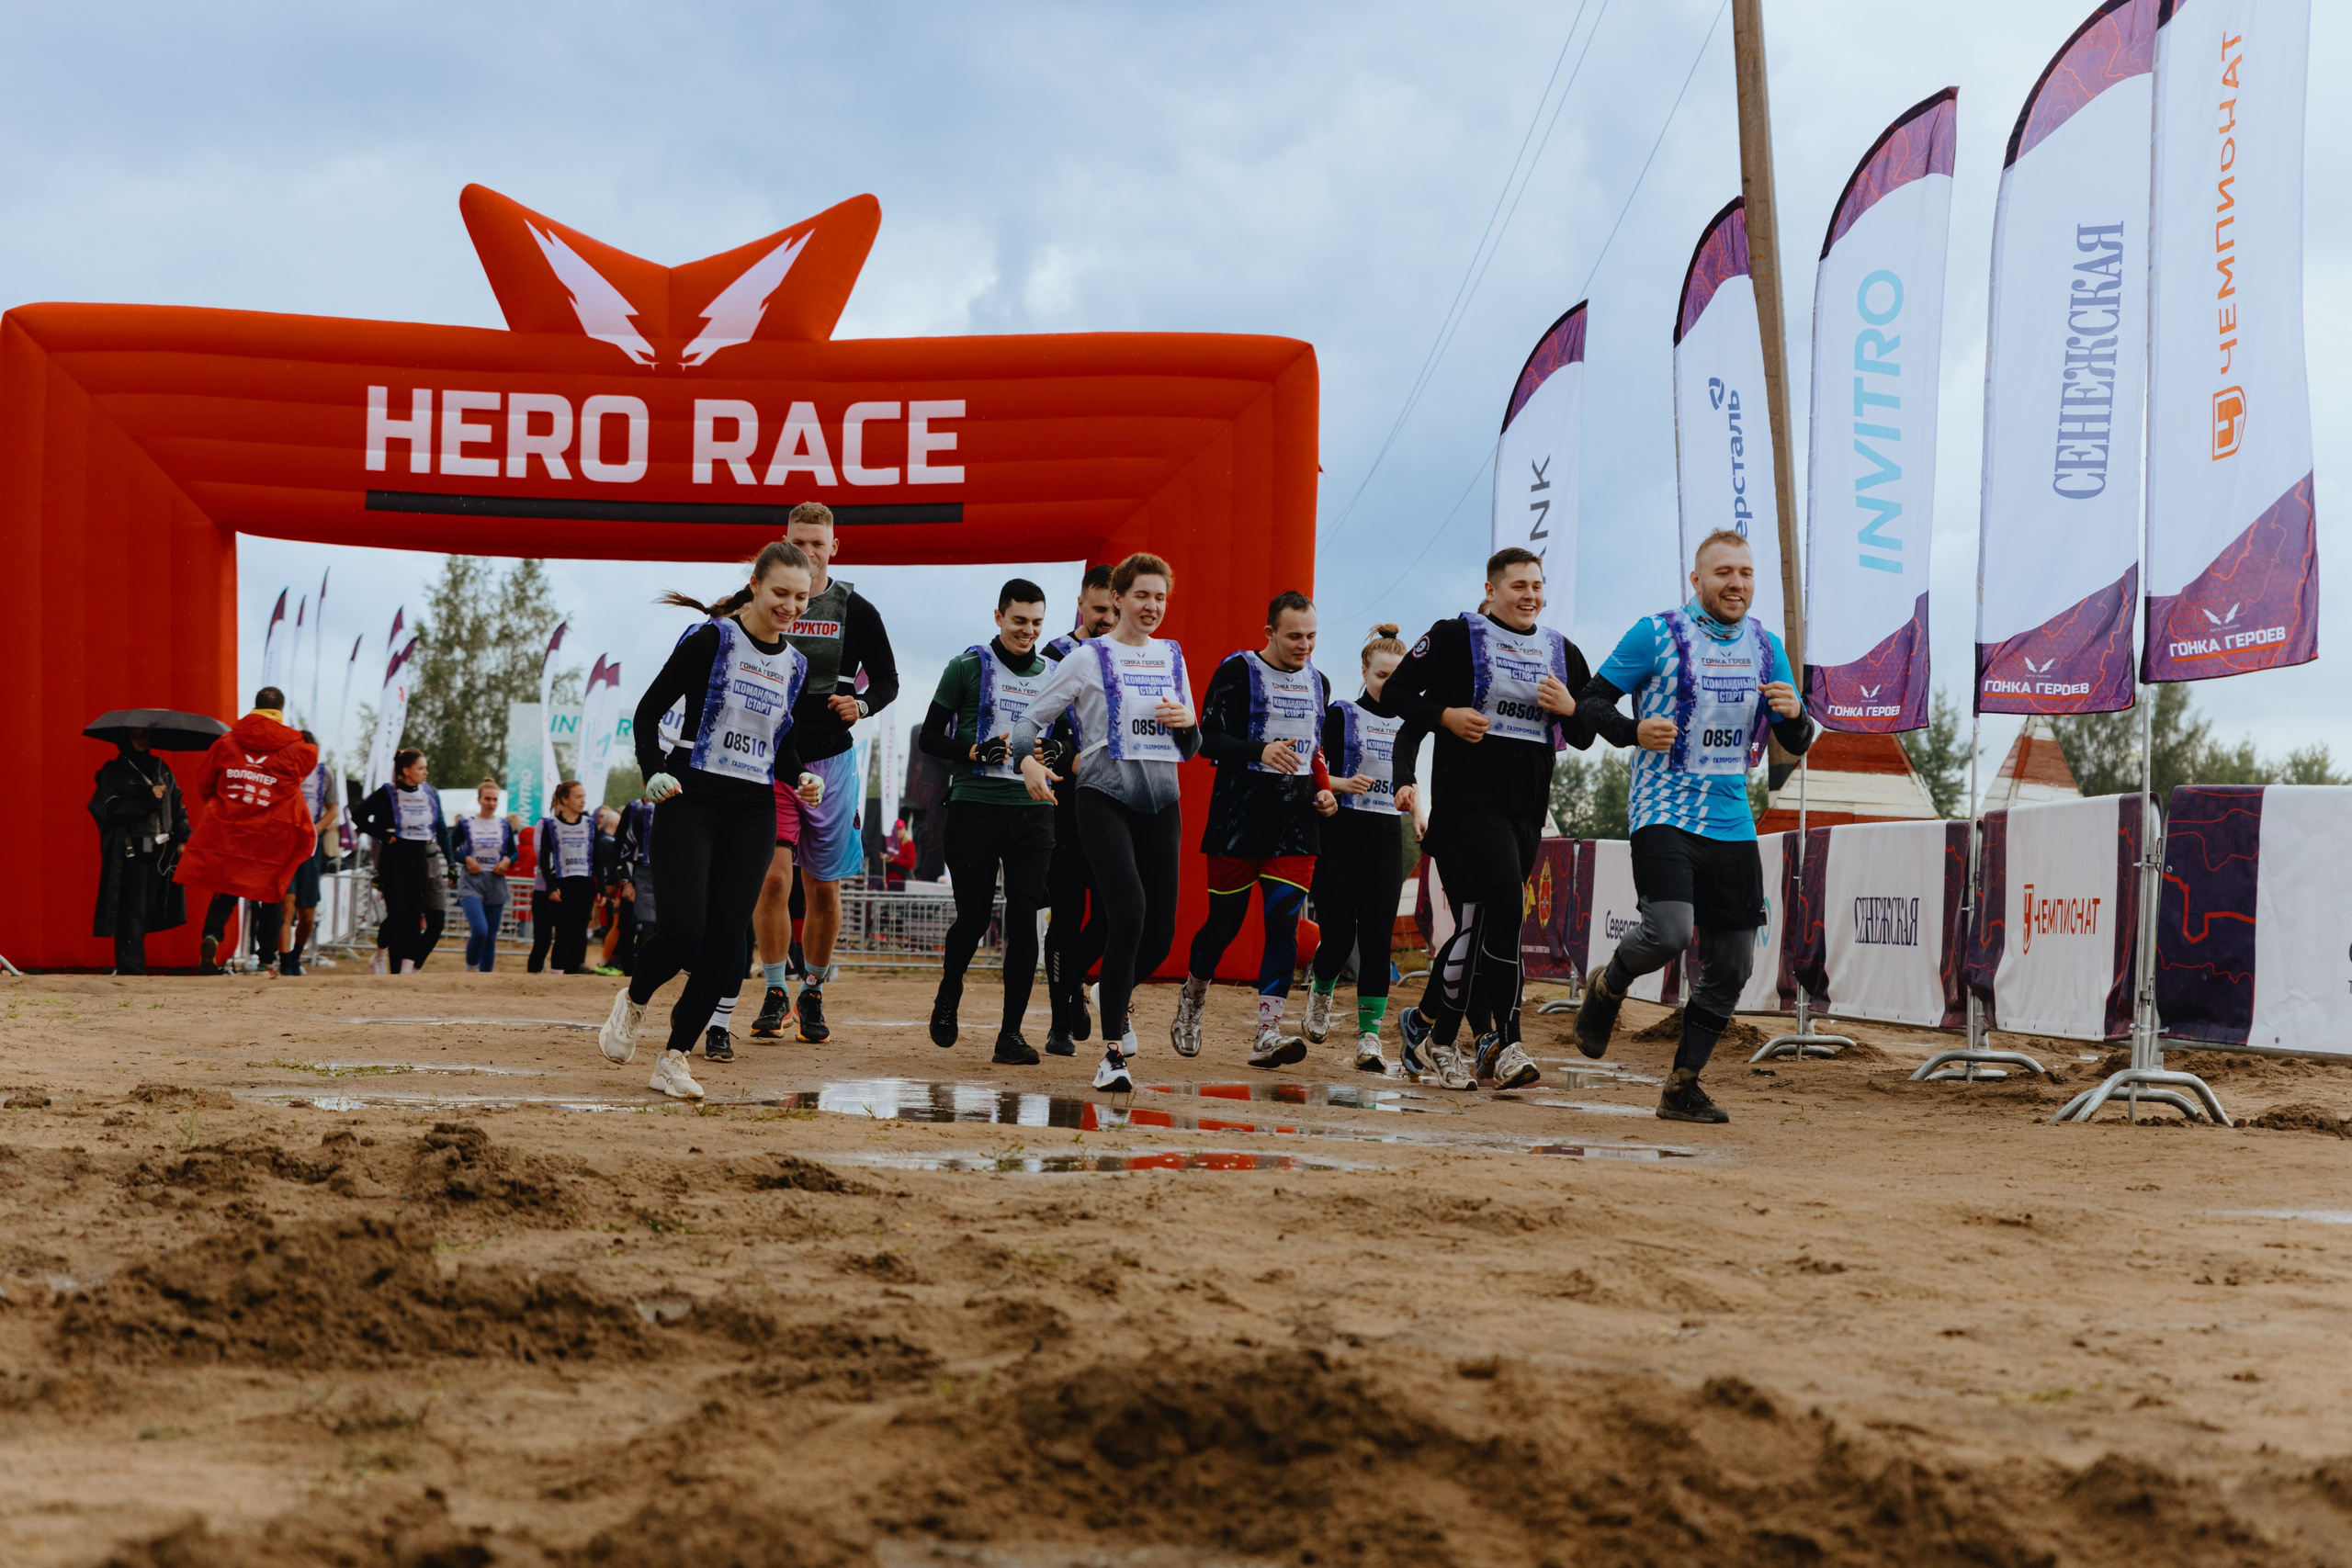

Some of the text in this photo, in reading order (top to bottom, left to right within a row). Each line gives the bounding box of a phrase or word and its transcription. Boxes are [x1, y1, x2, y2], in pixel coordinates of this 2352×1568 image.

[2216, 31, 2243, 375] ЧЕМПИОНАТ
[2052, 220, 2124, 501] СЕНЕЖСКАЯ
[1853, 269, 1905, 574] INVITRO
[366, 385, 966, 486] HERO RACE
[1727, 389, 1753, 539] ерсталь
[2169, 626, 2286, 657] ГОНКА ГЕРОЕВ
[740, 661, 784, 682] ГОНКА ГЕРОЕВ
[1498, 658, 1547, 673] КОМАНДНЫЙ
[1124, 674, 1171, 687] КОМАНДНЫЙ
[1512, 671, 1536, 682] СТАРТ
[1702, 677, 1756, 691] КОМАНДНЫЙ
[734, 681, 784, 706] КОМАНДНЫЙ
[1001, 684, 1022, 693] ГОНКА
[1139, 686, 1161, 695] СТАРТ
[1984, 680, 2089, 695] ГОНКА ГЕРОЕВ
[1272, 697, 1313, 711] КОМАНДНЫЙ
[1719, 691, 1743, 702] СТАРТ
[746, 698, 771, 715] СТАРТ
[1001, 700, 1026, 713] КОМАН
[1285, 709, 1304, 718] СТАРТ
[1497, 700, 1544, 721] 08503
[1827, 705, 1901, 716] ГОНКА ГЕРОЕВ
[1507, 725, 1541, 736] ГАЗПРОМБАНК
[1702, 728, 1745, 747] 0850
[723, 730, 767, 758] 08510
[1367, 740, 1394, 751] КОМАН
[1379, 750, 1393, 760] СТА
[226, 768, 277, 785] ВОЛОНТЕР
[2034, 897, 2100, 935] ЧЕМПИОНАТ
[1605, 909, 1640, 940] Север
